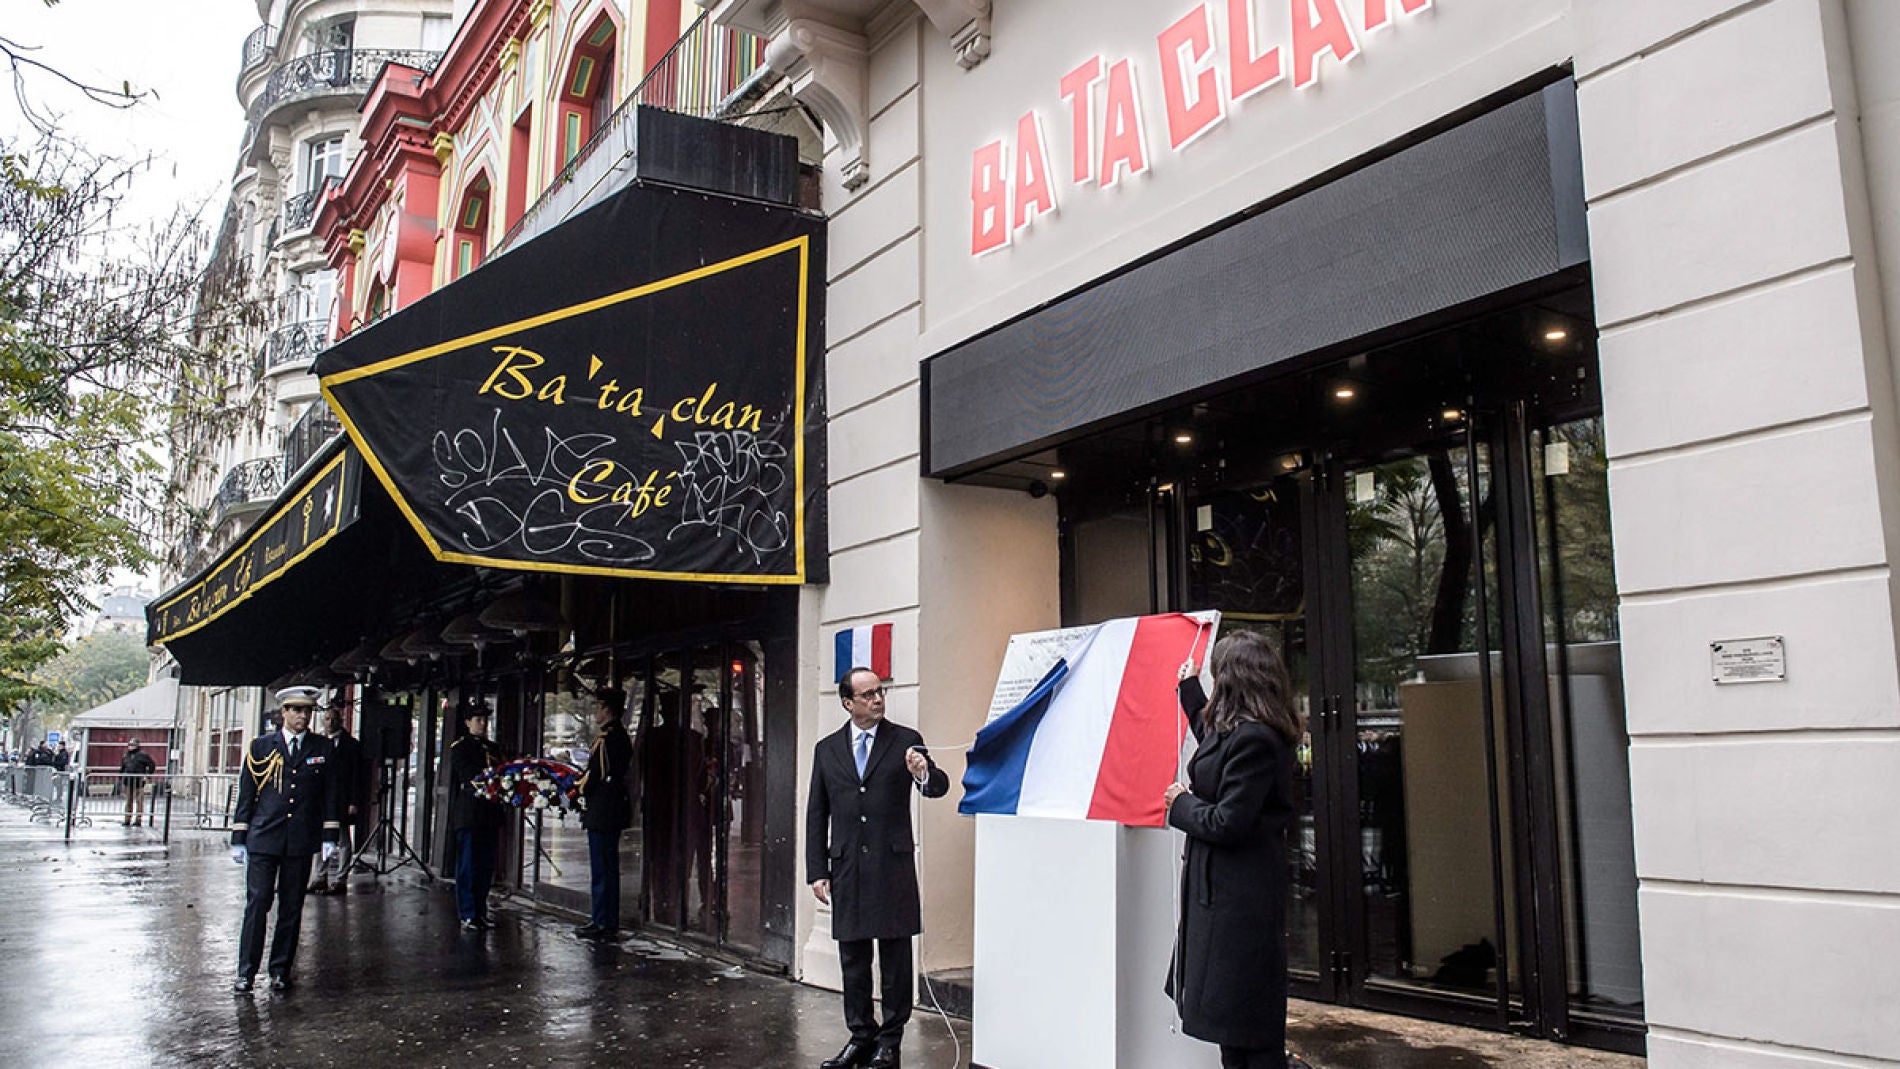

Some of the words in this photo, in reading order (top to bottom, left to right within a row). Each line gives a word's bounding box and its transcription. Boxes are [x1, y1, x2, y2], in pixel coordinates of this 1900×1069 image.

[971, 109, 1058, 257] BA
[1060, 55, 1149, 188] TA
[1157, 0, 1432, 151] CLA
[567, 459, 678, 519] Café
